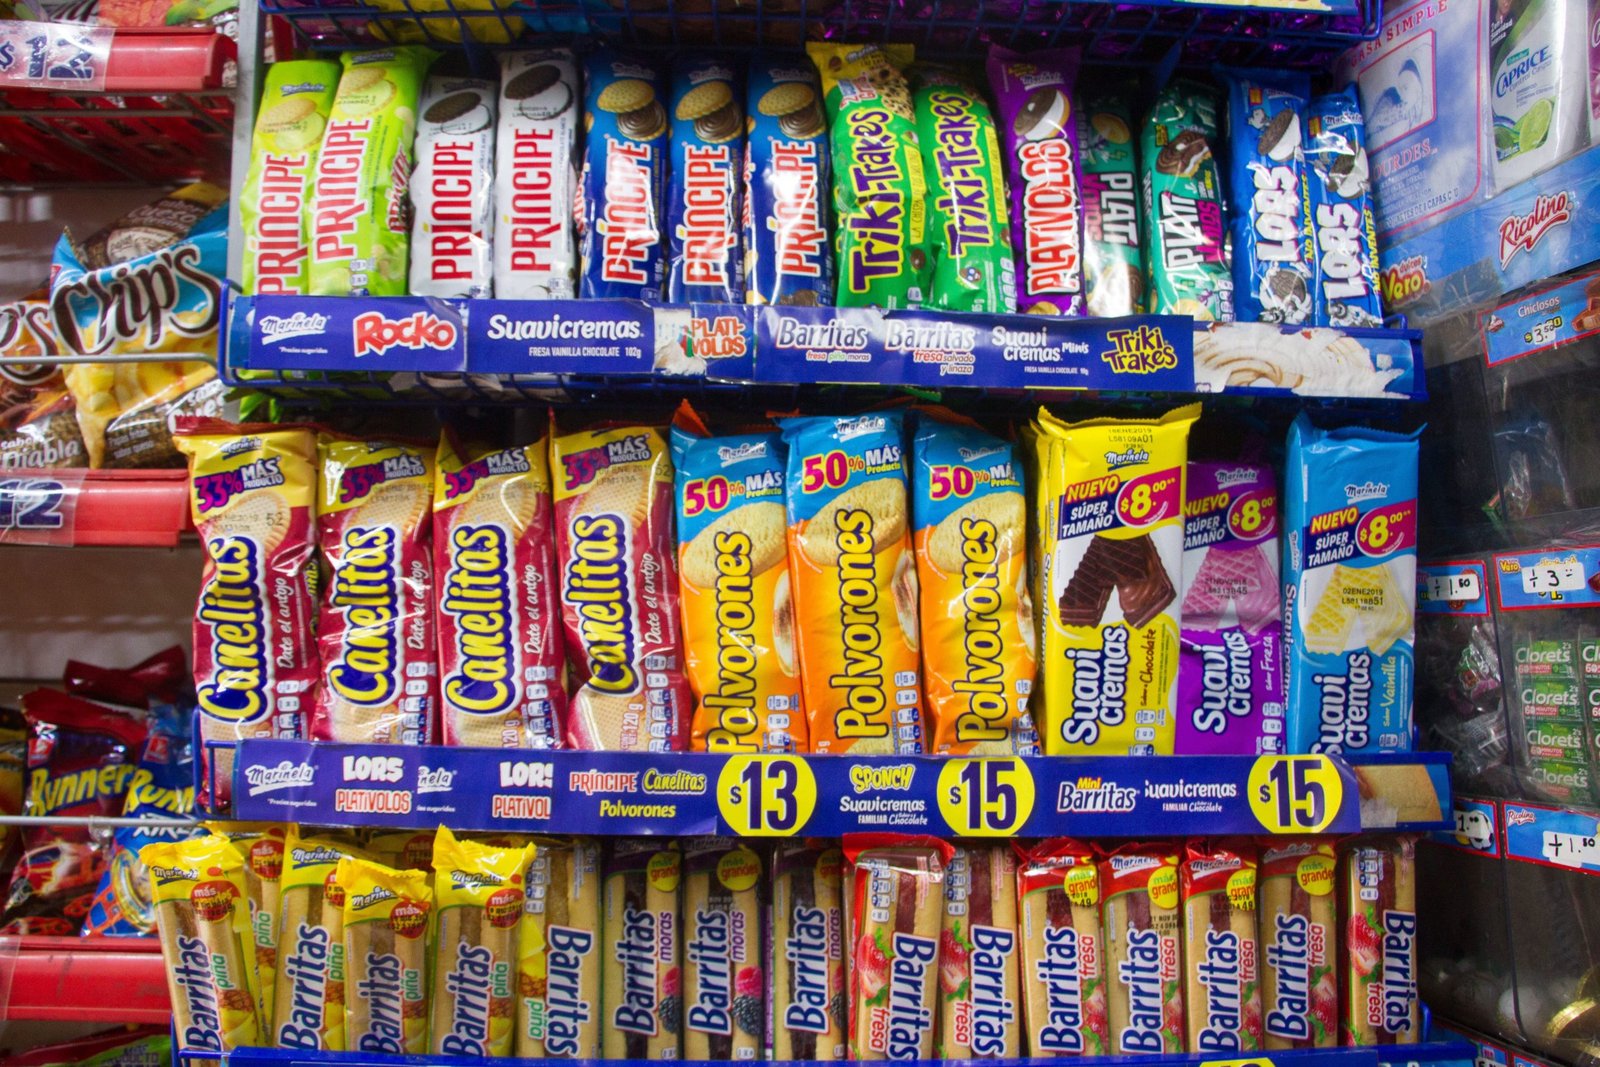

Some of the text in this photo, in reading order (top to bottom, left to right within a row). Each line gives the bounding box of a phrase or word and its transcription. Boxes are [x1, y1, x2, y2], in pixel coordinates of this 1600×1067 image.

[1386, 0, 1447, 41] SIMPLE
[1374, 138, 1431, 179] OURDES
[1499, 190, 1570, 265] Ricolino
[1518, 296, 1561, 318] Chiclosos
[260, 311, 326, 340] Marinela
[487, 313, 642, 341] Suavicremas
[776, 317, 976, 353] Barritas Barritas
[992, 326, 1048, 348] Suavi
[1107, 325, 1164, 354] Triki
[529, 346, 550, 356] FRESA
[550, 347, 581, 357] VAINILLA
[582, 347, 620, 357] CHOCOLATE
[847, 352, 871, 362] moras
[913, 350, 943, 363] fresa
[1101, 344, 1178, 375] Trakes
[487, 450, 527, 467] MÁS
[608, 437, 649, 454] MÁS
[610, 450, 652, 464] PRODUCTO
[865, 444, 900, 466] MÁS
[1104, 448, 1150, 470] Marinela
[384, 455, 422, 472] MÁS
[745, 471, 783, 491] MÁS
[194, 459, 280, 514] 33% MÁS
[244, 474, 284, 489] PRODUCTO
[1066, 475, 1121, 503] NUEVO
[1344, 481, 1388, 501] Marinela
[1070, 501, 1108, 521] SÚPER
[1184, 492, 1229, 517] NUEVO
[1311, 506, 1359, 534] NUEVO
[1062, 513, 1114, 538] TAMAÑO
[1186, 516, 1220, 534] SÚPER
[1315, 531, 1349, 551] SÚPER
[640, 552, 661, 594] antojo
[1308, 545, 1355, 568] TAMAÑO
[525, 563, 544, 605] antojo
[330, 526, 396, 705] Canelitas
[444, 526, 512, 713] Canelitas
[565, 516, 637, 695] Canelitas
[196, 535, 270, 724] Canelitas
[407, 620, 426, 650] Date
[525, 623, 542, 655] Date
[644, 611, 662, 645] Date
[703, 530, 758, 753] Polvorones
[829, 508, 889, 741] Polvorones
[952, 516, 1009, 743] Polvorones
[277, 639, 295, 669] Date
[1139, 628, 1157, 683] Chocolate
[1515, 646, 1572, 664] Clorets
[1099, 626, 1130, 726] cremas
[1192, 644, 1229, 735] Suavi
[1223, 630, 1252, 717] cremas
[1380, 655, 1397, 707] Vainilla
[1061, 649, 1101, 746] Suavi
[1345, 653, 1372, 748] cremas
[1521, 688, 1580, 706] Clorets
[1526, 729, 1582, 749] Clorets
[245, 761, 314, 790] Marinela
[343, 756, 404, 783] LORS
[642, 768, 707, 796] Canelitas
[850, 763, 916, 794] SPONCH
[1077, 777, 1102, 790] Mini
[1532, 767, 1589, 788] Clorets
[336, 789, 413, 814] PLATIVOLOS
[600, 799, 677, 818] Polvorones
[840, 796, 925, 814] Suavicremas
[1057, 781, 1137, 812] Barritas
[1162, 803, 1223, 813] FAMILIAR Chocolate
[858, 814, 928, 826] FAMILIAR Chocolate
[1507, 809, 1536, 827] Ricolino
[657, 911, 674, 963] moras
[730, 911, 746, 963] moras
[828, 908, 842, 960] moras
[1306, 924, 1325, 967] fresa
[615, 908, 657, 1036] Barritas
[687, 909, 732, 1035] Barritas
[784, 906, 830, 1035] Barritas
[1078, 935, 1096, 979] fresa
[1160, 937, 1178, 982] fresa
[1238, 939, 1256, 983] fresa
[1383, 910, 1418, 1034] Barritas
[175, 935, 224, 1051] Barritas
[280, 923, 329, 1051] Barritas
[547, 924, 595, 1057] Barritas
[970, 924, 1015, 1057] Barritas
[1037, 926, 1083, 1052] Barritas
[1120, 929, 1164, 1053] Barritas
[1198, 929, 1242, 1052] Barritas
[1266, 912, 1310, 1040] Barritas
[359, 952, 401, 1053] Barritas
[442, 943, 494, 1057] Barritas
[887, 932, 936, 1060] Barritas
[1367, 983, 1384, 1027] fresa
[869, 1006, 891, 1051] fresa
[953, 1000, 973, 1046] fresa
